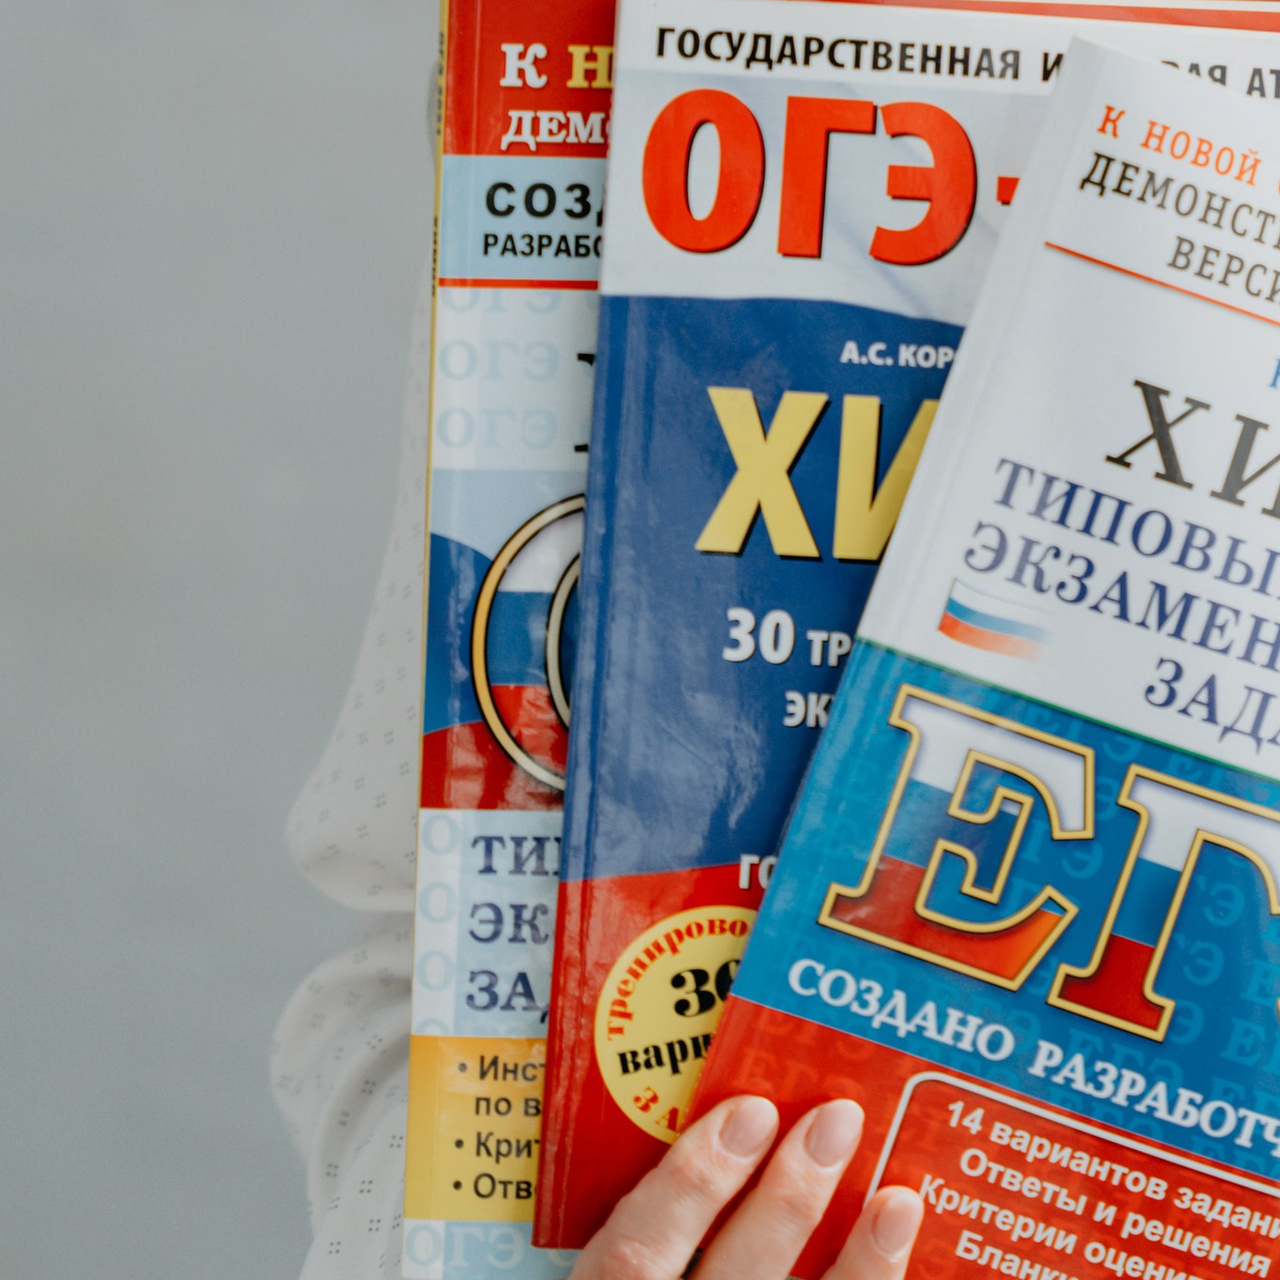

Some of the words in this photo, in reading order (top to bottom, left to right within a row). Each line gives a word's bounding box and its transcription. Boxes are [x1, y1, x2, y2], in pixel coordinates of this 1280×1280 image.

[500, 43, 547, 88] К
[656, 26, 1020, 80] ГОСУДАРСТВЕННАЯ
[500, 110, 613, 151] ДЕМ
[1097, 105, 1126, 140] К
[1140, 119, 1262, 186] НОВОЙ
[485, 182, 605, 227] СОЗ
[839, 340, 894, 366] А.С.
[722, 607, 795, 664] 30
[783, 690, 835, 728] ЭК
[471, 836, 561, 876] ТИ
[466, 970, 549, 1024] ЗА
[788, 959, 1015, 1061] СОЗДАНО
[475, 1097, 512, 1116] по
[947, 1100, 985, 1135] 14
[989, 1121, 1168, 1201] вариантов
[473, 1172, 536, 1200] Отв
[920, 1174, 1077, 1255] Критерии
[960, 1148, 1087, 1216] Ответы
[1093, 1202, 1118, 1226] и
[1121, 1211, 1271, 1280] решения
[955, 1230, 1080, 1280] Бланк
